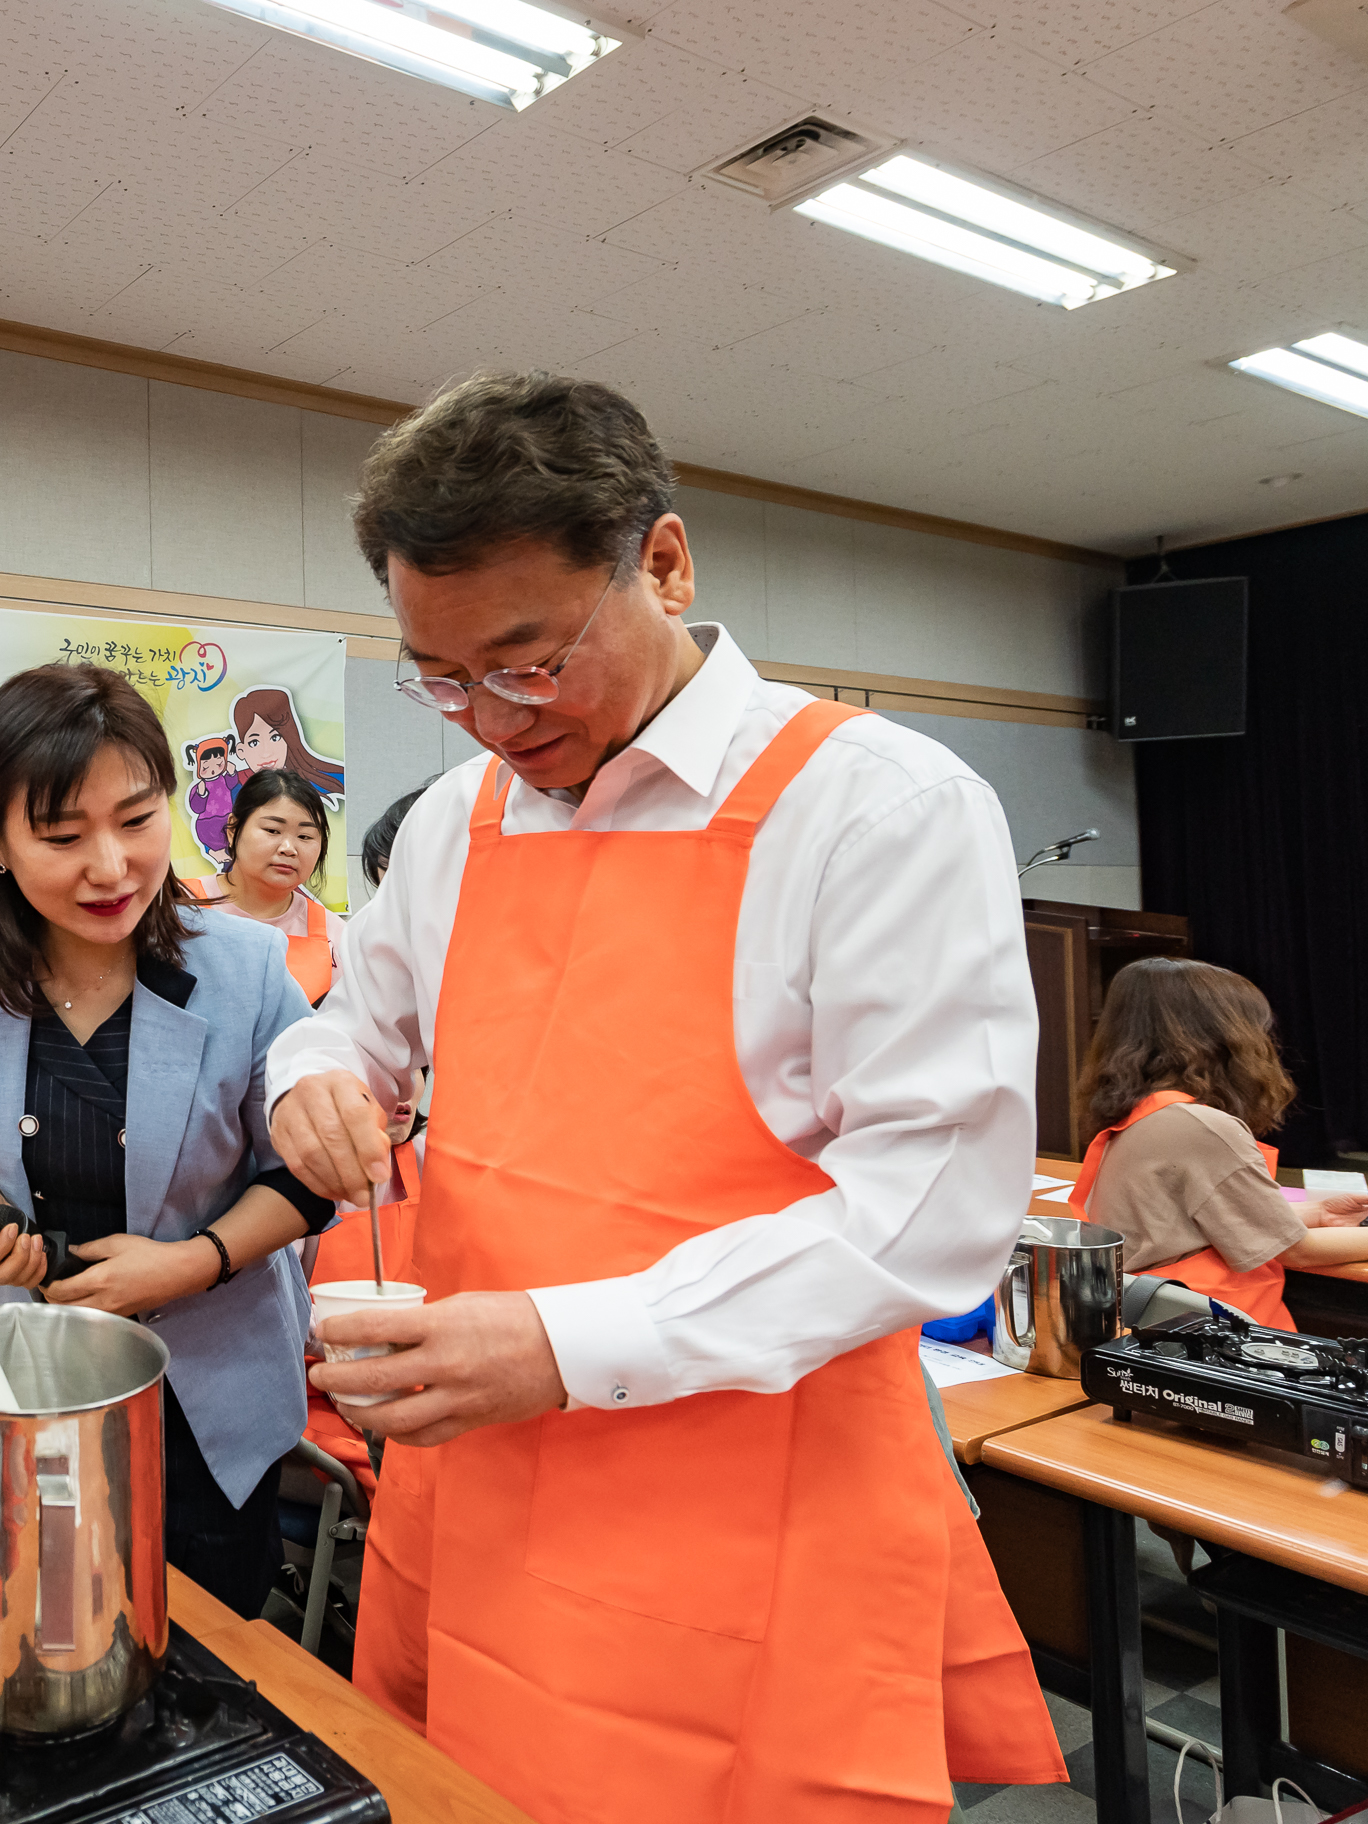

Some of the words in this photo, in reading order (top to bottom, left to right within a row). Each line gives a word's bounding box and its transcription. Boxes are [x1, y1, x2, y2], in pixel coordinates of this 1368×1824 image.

[59, 638, 101, 664] 구민이
[104, 640, 147, 666] 꿈꾸는
[148, 647, 177, 664] 가치
[1119, 1379, 1159, 1400] 썬터치
[1162, 1389, 1222, 1412] Original
